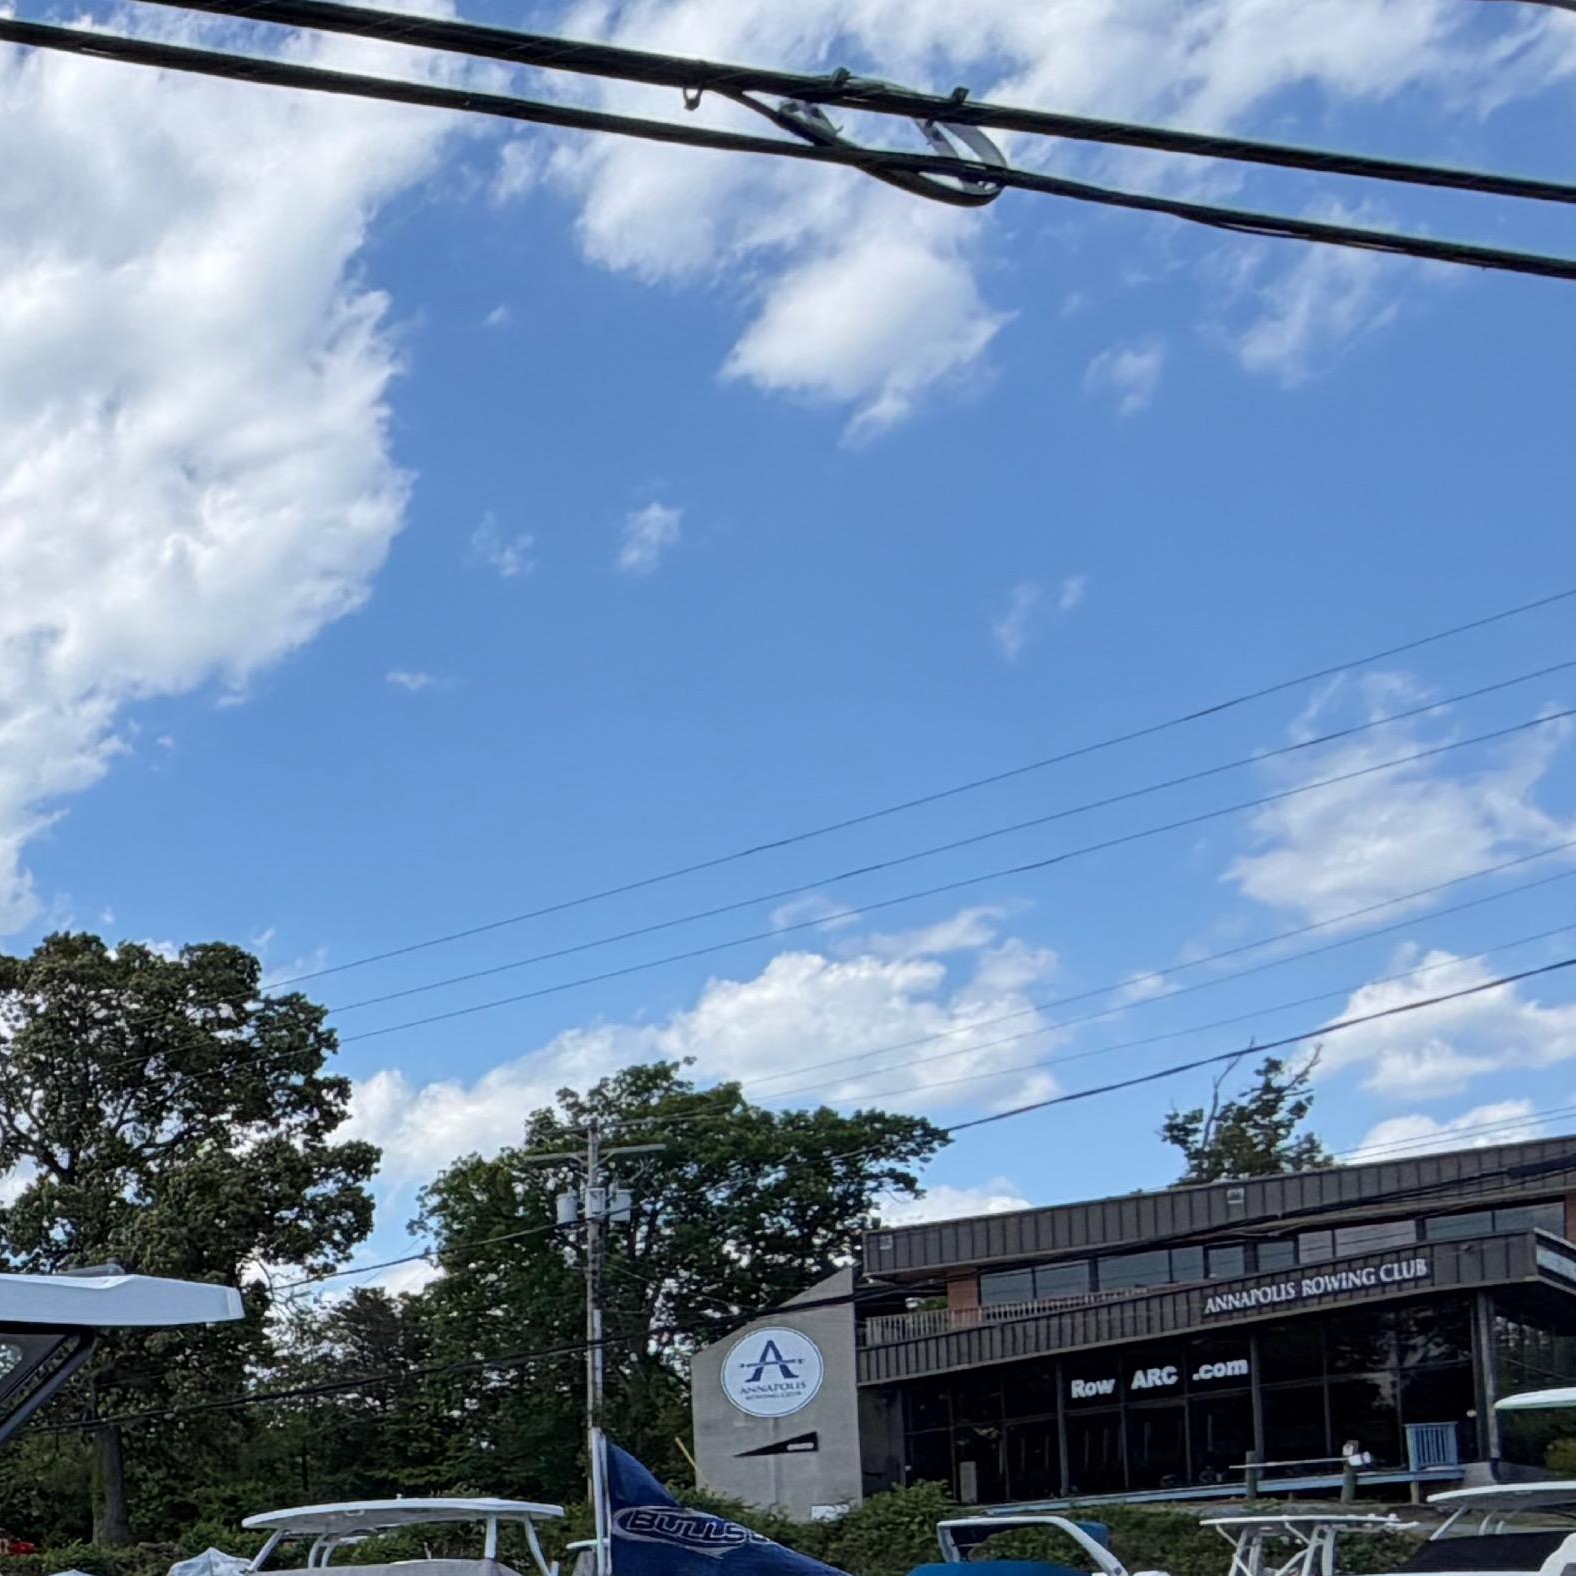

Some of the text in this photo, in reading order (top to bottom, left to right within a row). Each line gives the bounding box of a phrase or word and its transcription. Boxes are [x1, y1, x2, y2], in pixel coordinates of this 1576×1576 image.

[1204, 1258, 1428, 1315] ANNAPOLIS ROWING CLUB
[740, 1381, 807, 1394] ANNAPOLIS
[1070, 1358, 1249, 1399] Row ARC .com
